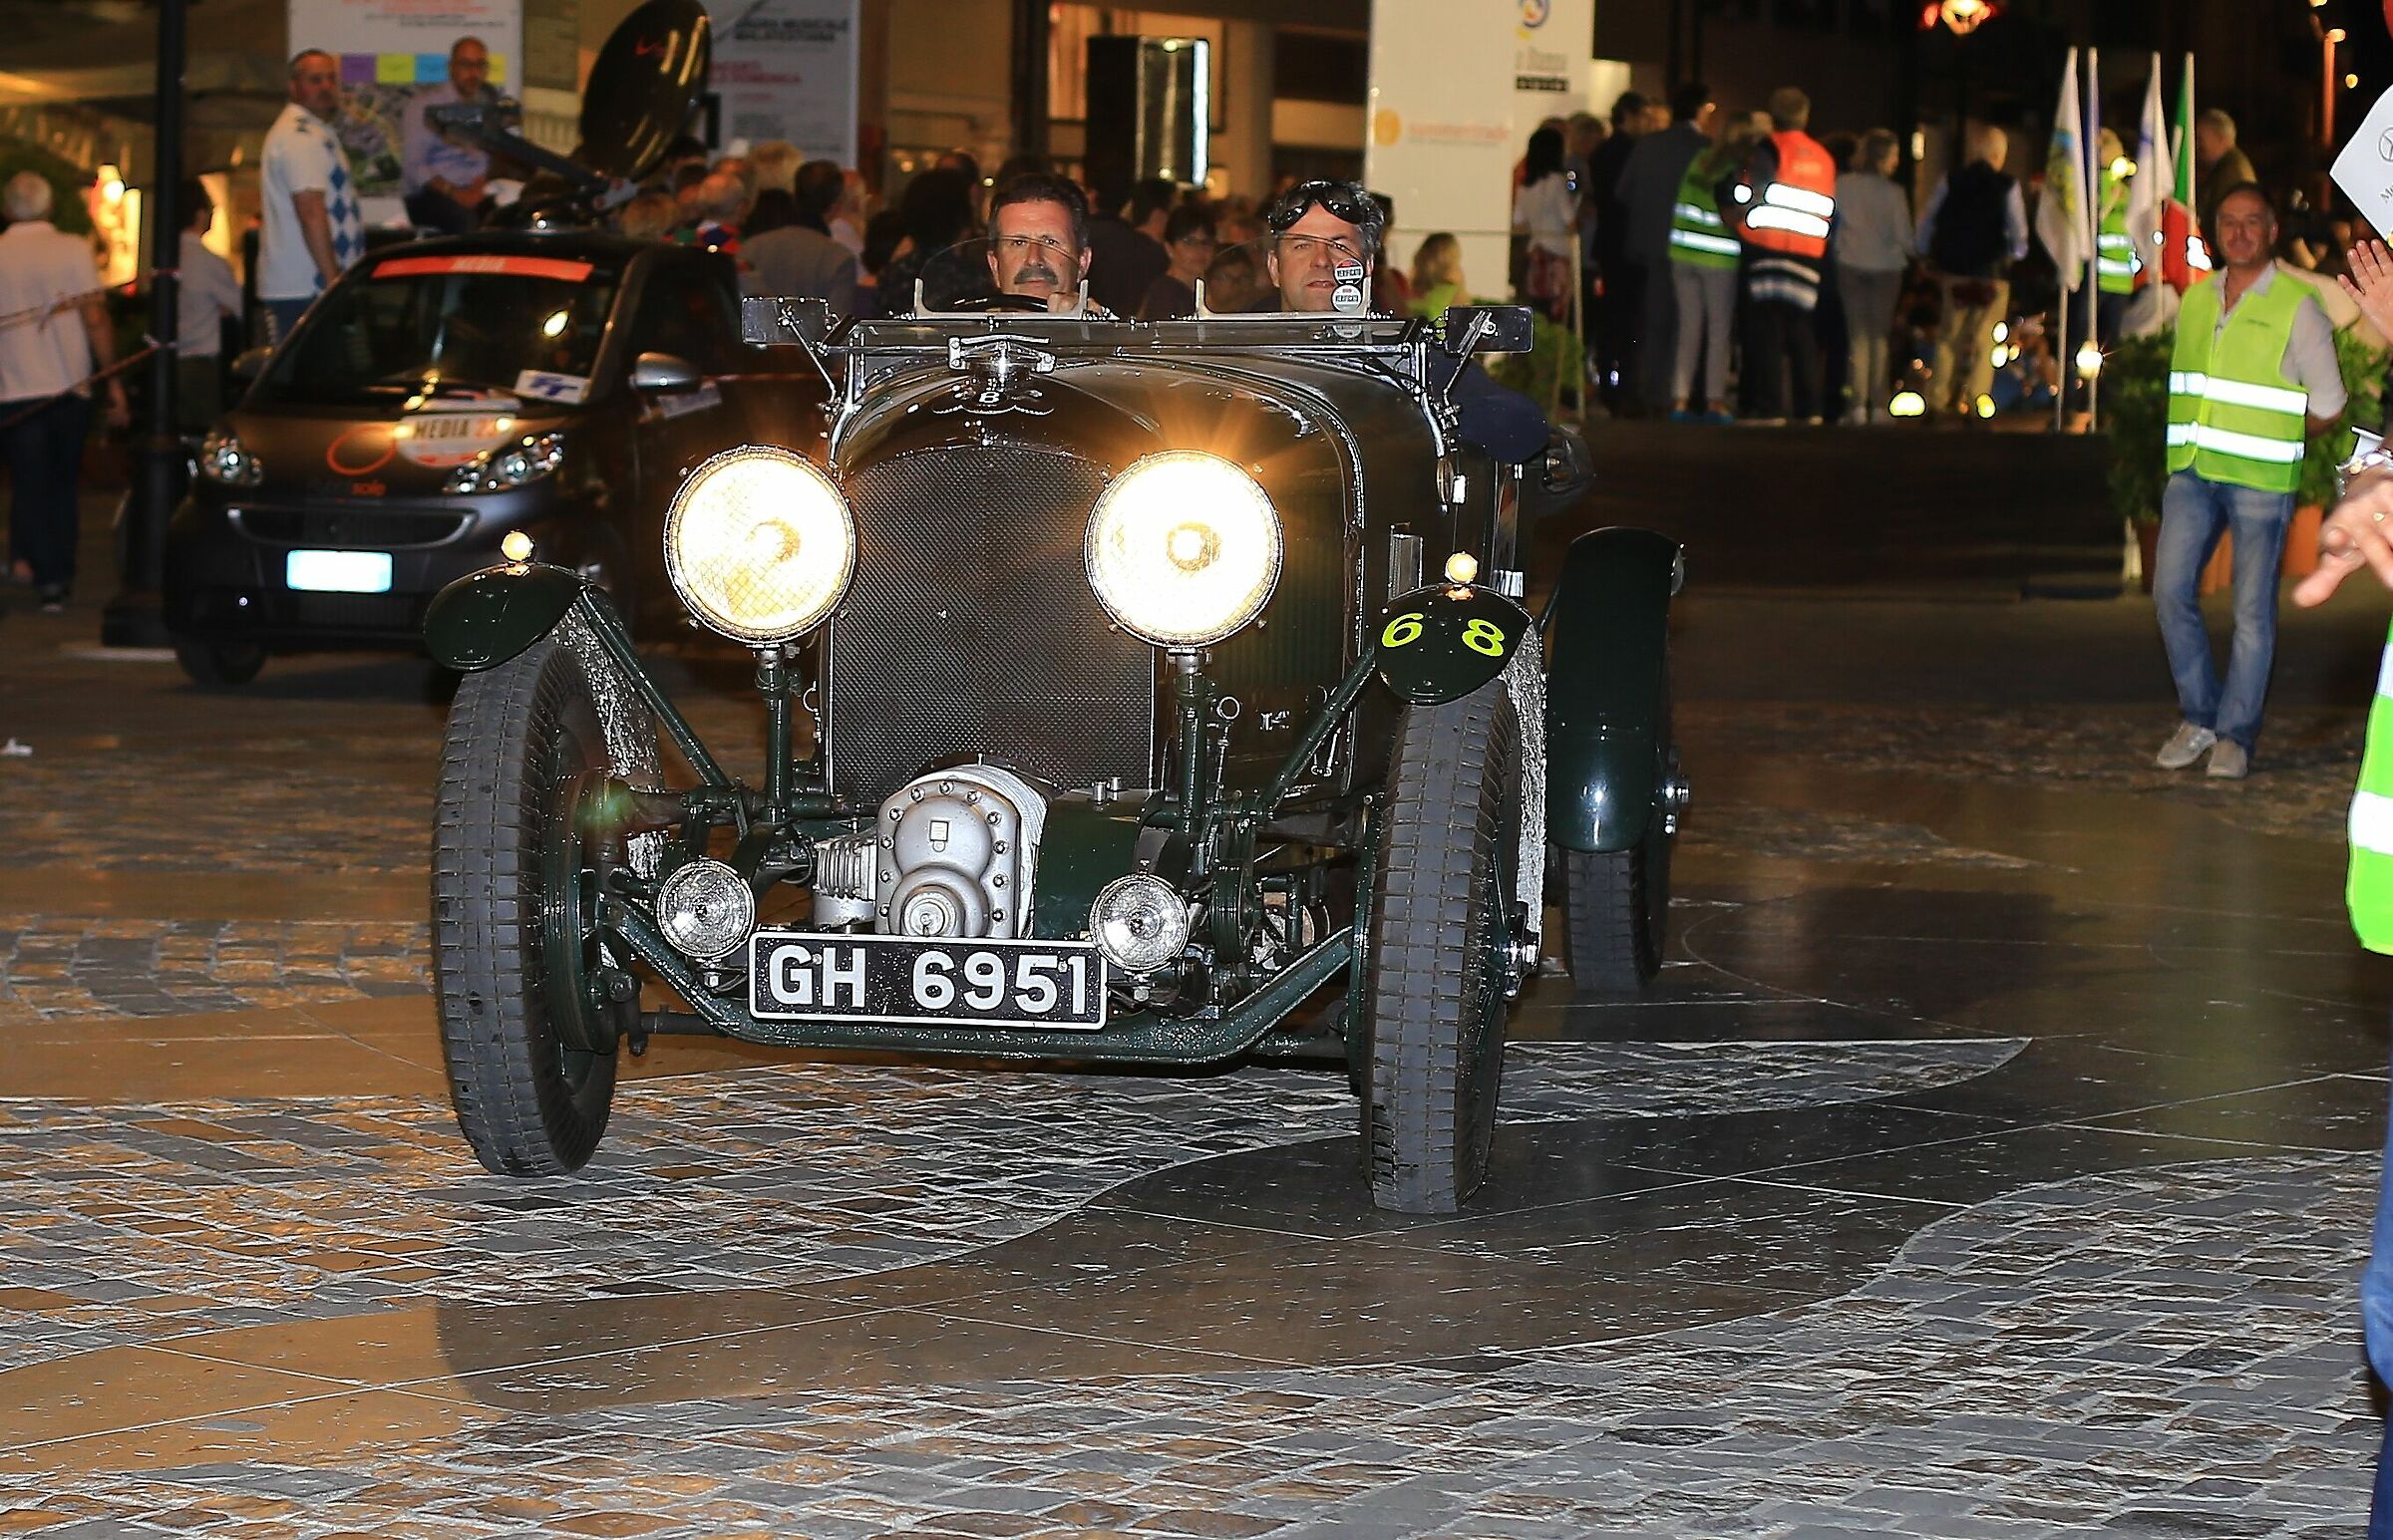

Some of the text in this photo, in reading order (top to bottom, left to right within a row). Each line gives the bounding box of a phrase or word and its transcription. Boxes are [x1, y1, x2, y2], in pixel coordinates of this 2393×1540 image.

[413, 419, 469, 439] MEDIA
[768, 944, 1087, 1016] GH 6951
